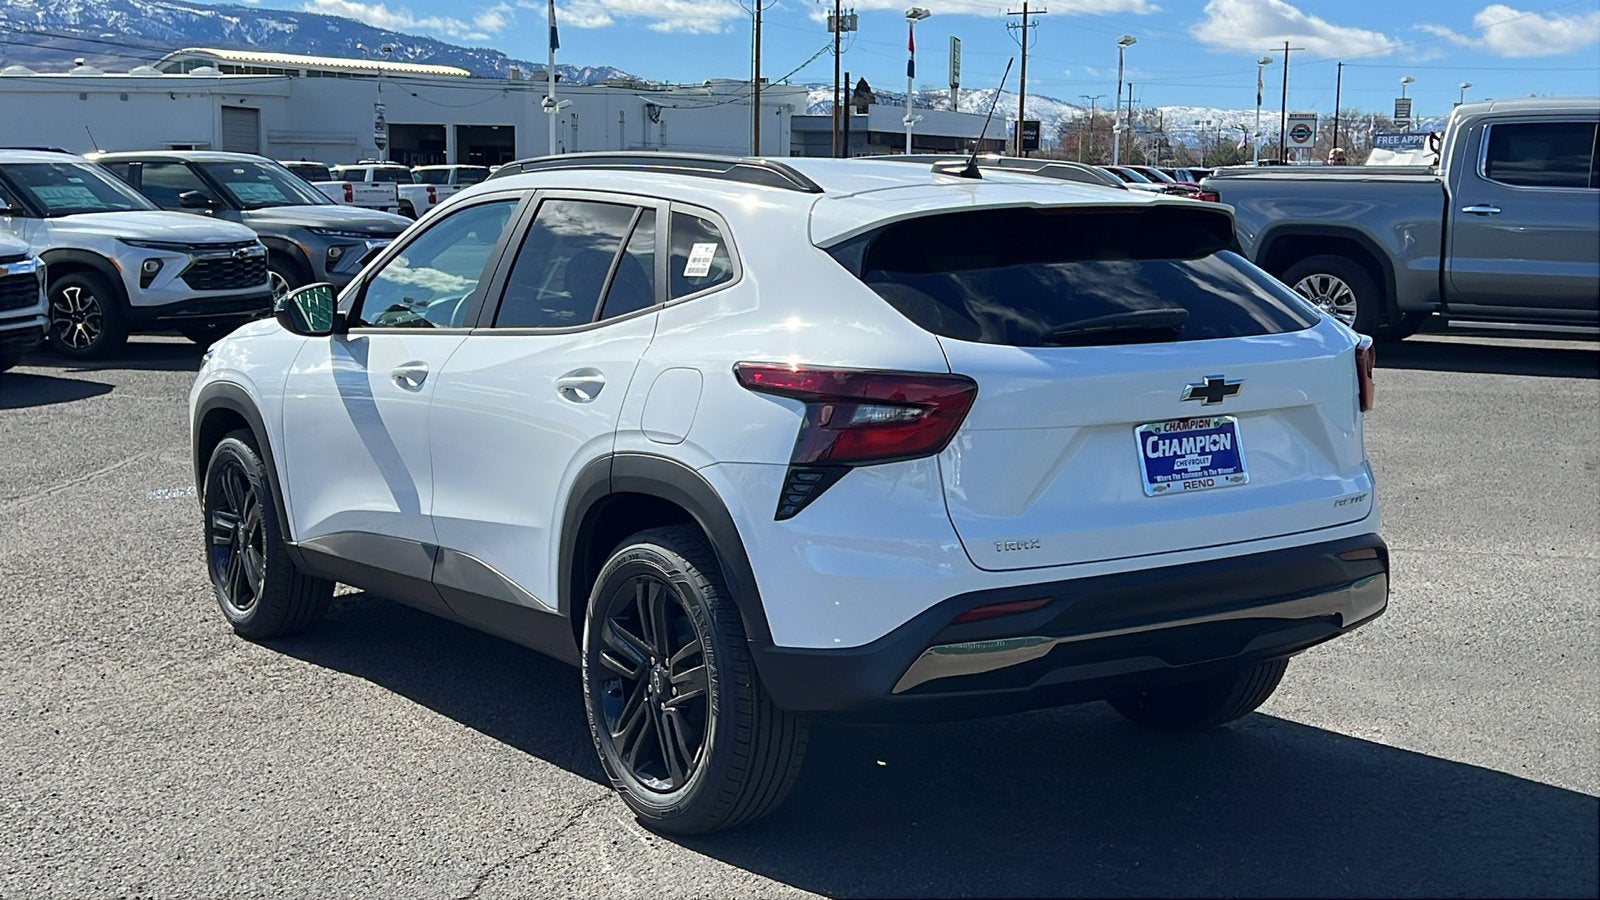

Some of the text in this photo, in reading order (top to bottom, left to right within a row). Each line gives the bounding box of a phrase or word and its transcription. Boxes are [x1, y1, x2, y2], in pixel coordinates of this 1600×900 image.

[1376, 135, 1400, 144] FREE
[1164, 419, 1211, 432] CHAMPION
[1146, 433, 1231, 459] CHAMPION
[1176, 457, 1210, 467] CHEVROLET
[1183, 478, 1215, 490] RENO
